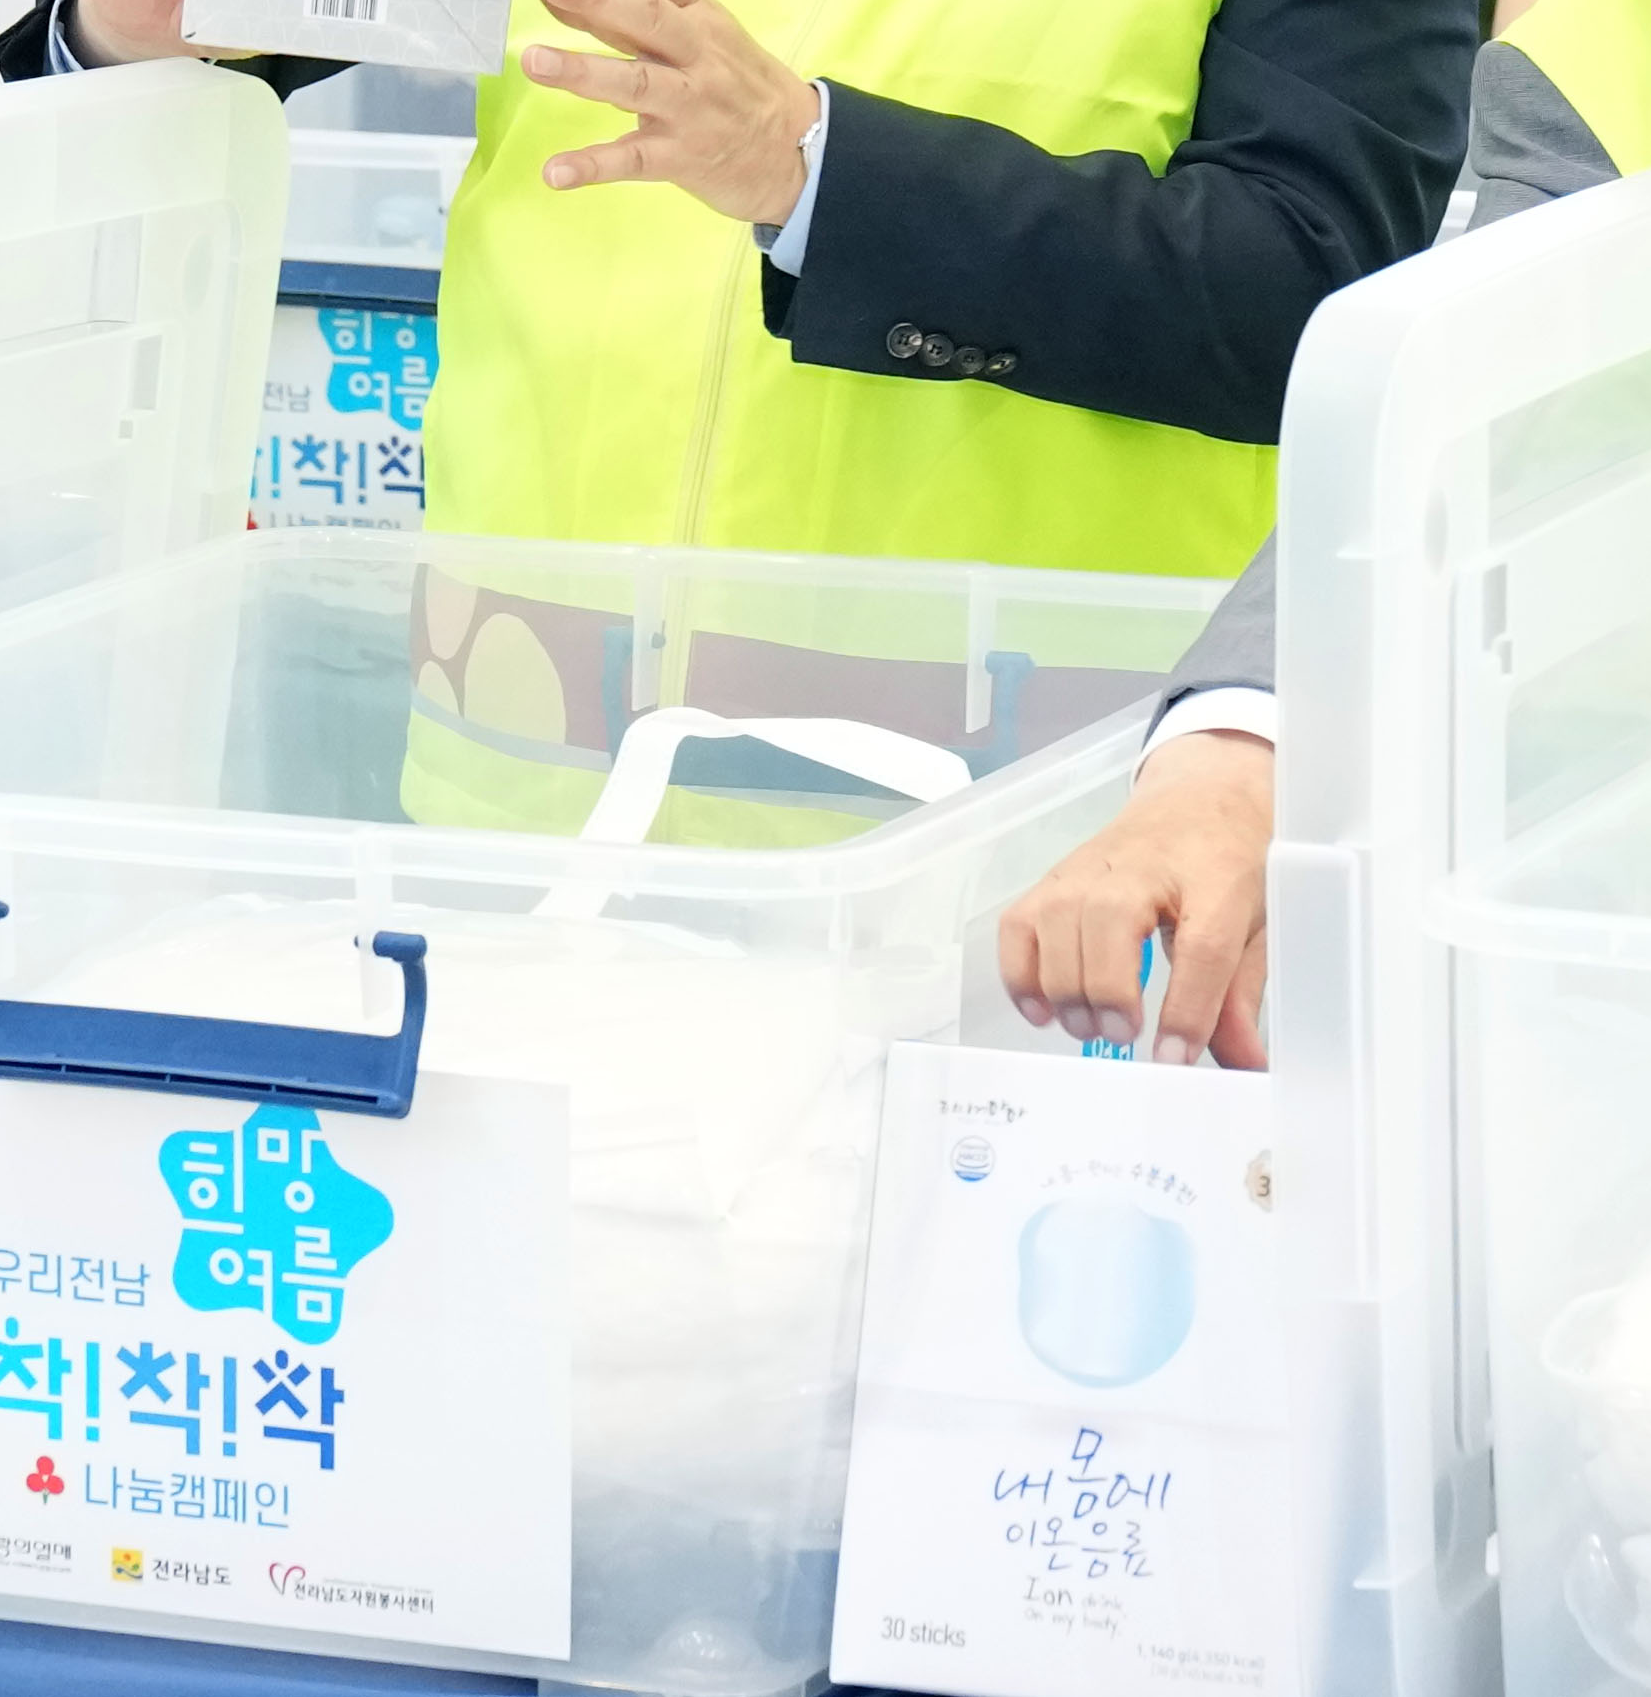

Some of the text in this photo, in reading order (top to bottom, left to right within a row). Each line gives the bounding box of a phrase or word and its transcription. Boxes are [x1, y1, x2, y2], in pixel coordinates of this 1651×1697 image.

[182, 1123, 330, 1234] 희망
[207, 1223, 349, 1325] 여름
[83, 1461, 292, 1530] 나눔캠페인
[994, 1469, 1052, 1503] 내
[1007, 1516, 1153, 1580] 이온음료
[151, 1559, 233, 1587] 전라남도
[1023, 1575, 1073, 1606] Ion
[881, 1616, 966, 1648] 30 sticks
